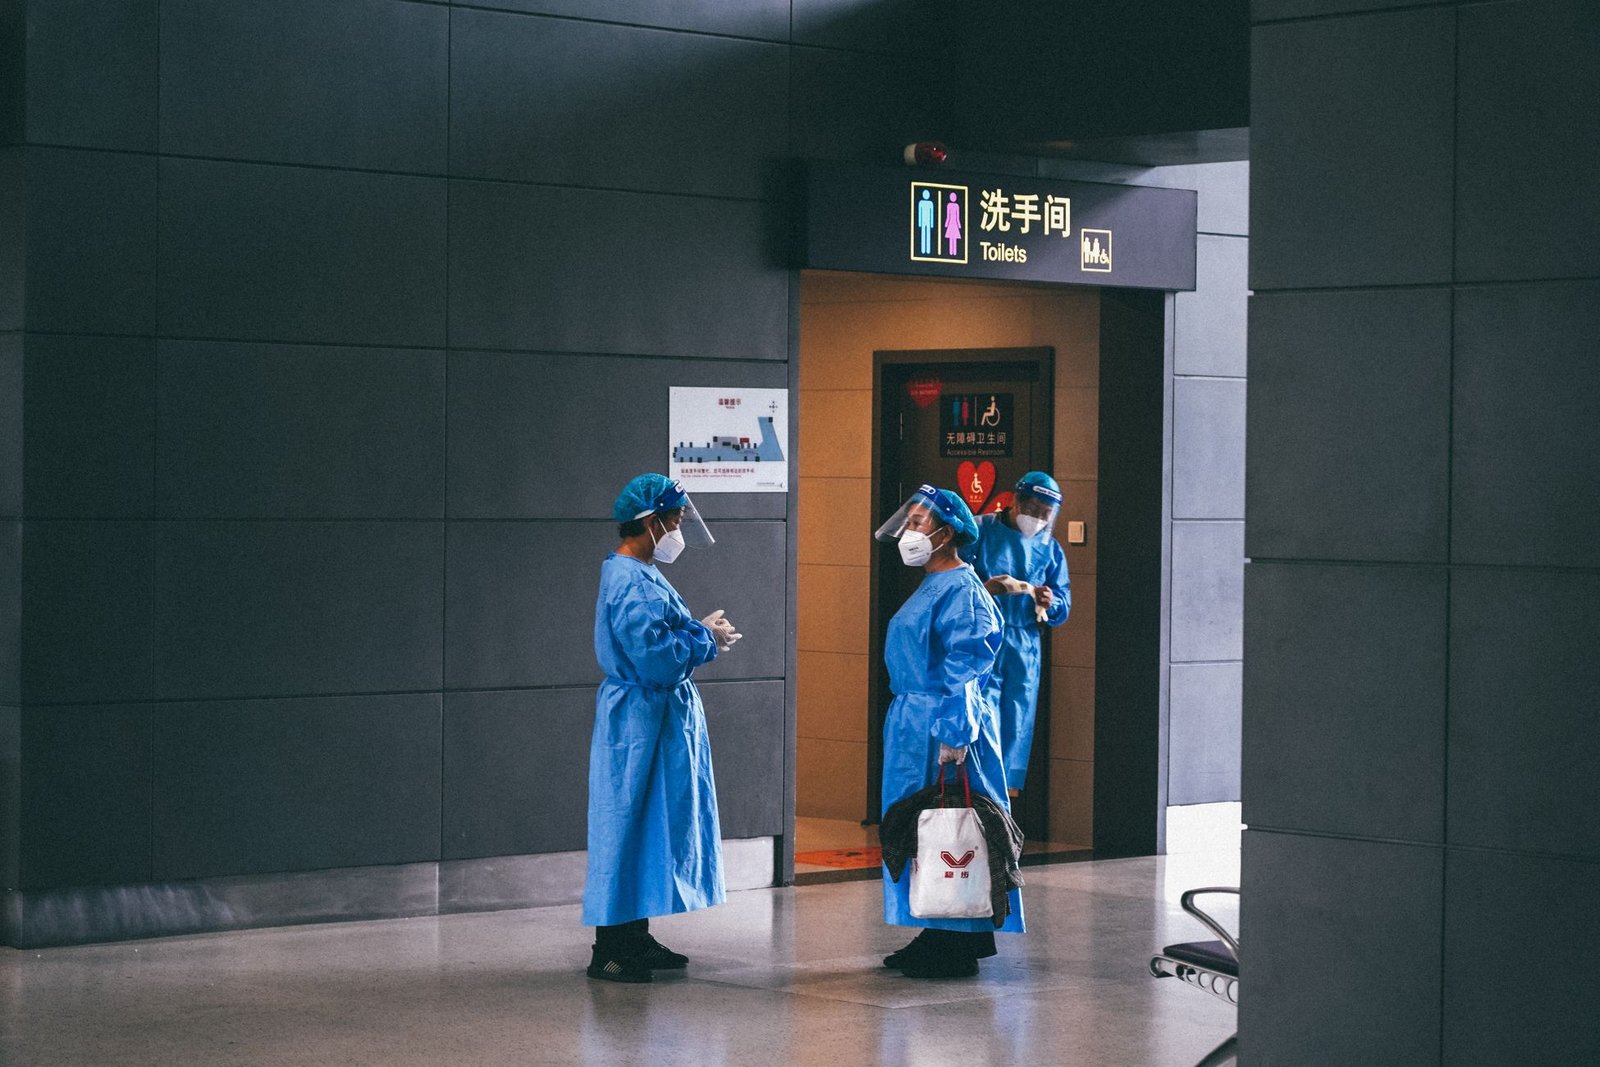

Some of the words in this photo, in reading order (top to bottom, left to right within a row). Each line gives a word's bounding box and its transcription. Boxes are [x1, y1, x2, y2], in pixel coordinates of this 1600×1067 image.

[980, 188, 1071, 238] 洗手间
[979, 241, 1028, 264] Toilets
[946, 432, 1007, 445] 无障碍卫生间
